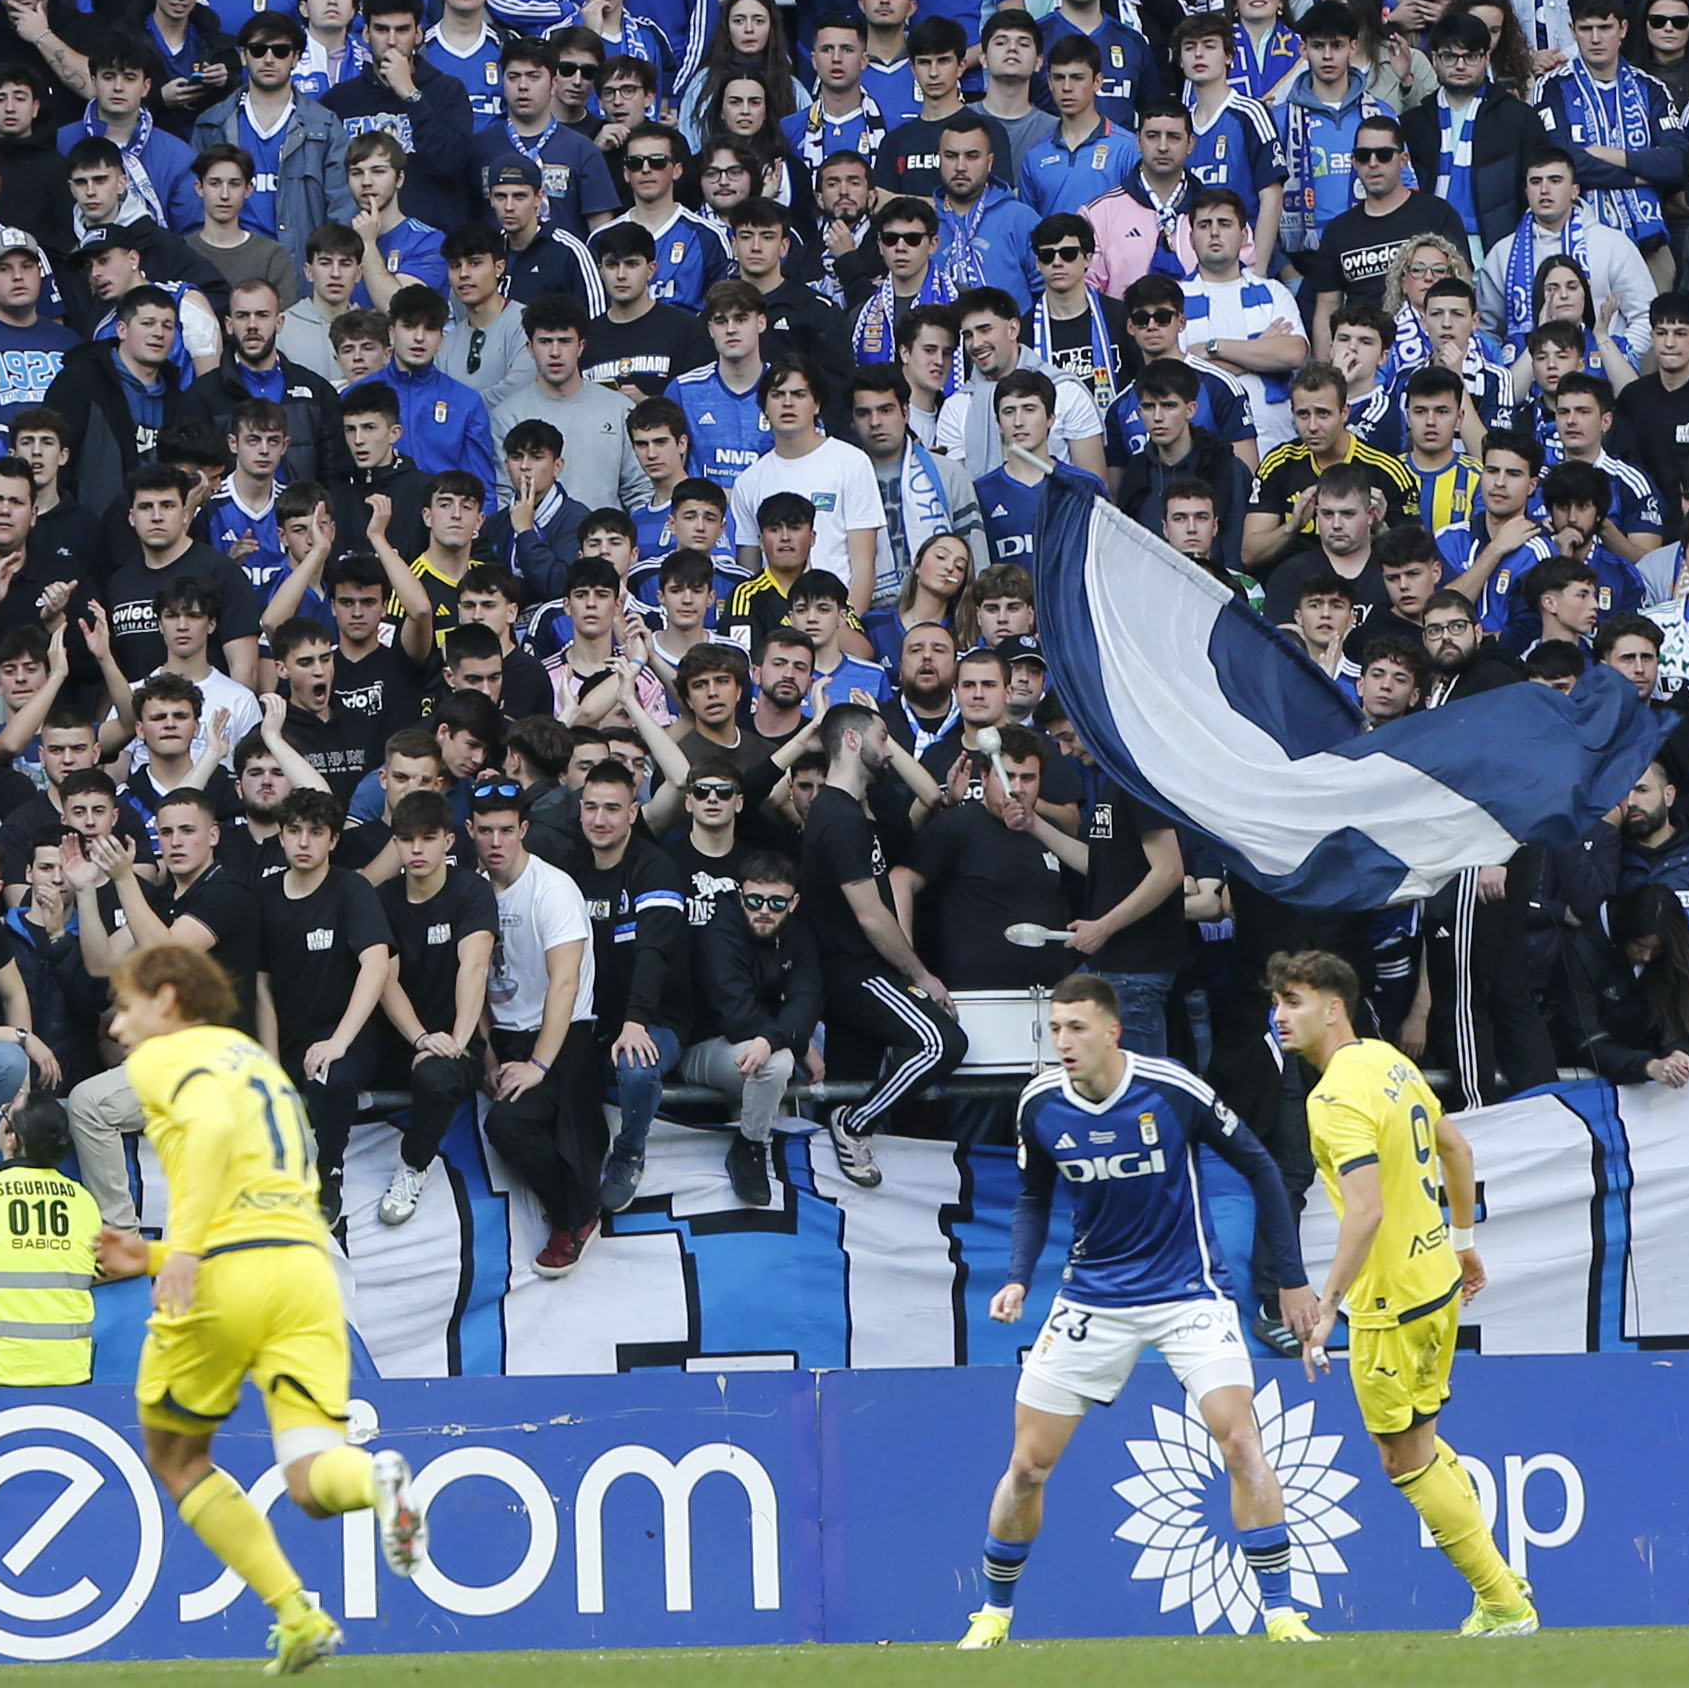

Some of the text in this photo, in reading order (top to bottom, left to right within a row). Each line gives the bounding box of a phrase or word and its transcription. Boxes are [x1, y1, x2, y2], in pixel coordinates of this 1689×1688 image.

[1056, 1148, 1167, 1179] DIGI
[7, 1199, 70, 1237] 016
[11, 1237, 72, 1252] SABICO
[1049, 1305, 1092, 1343] 23
